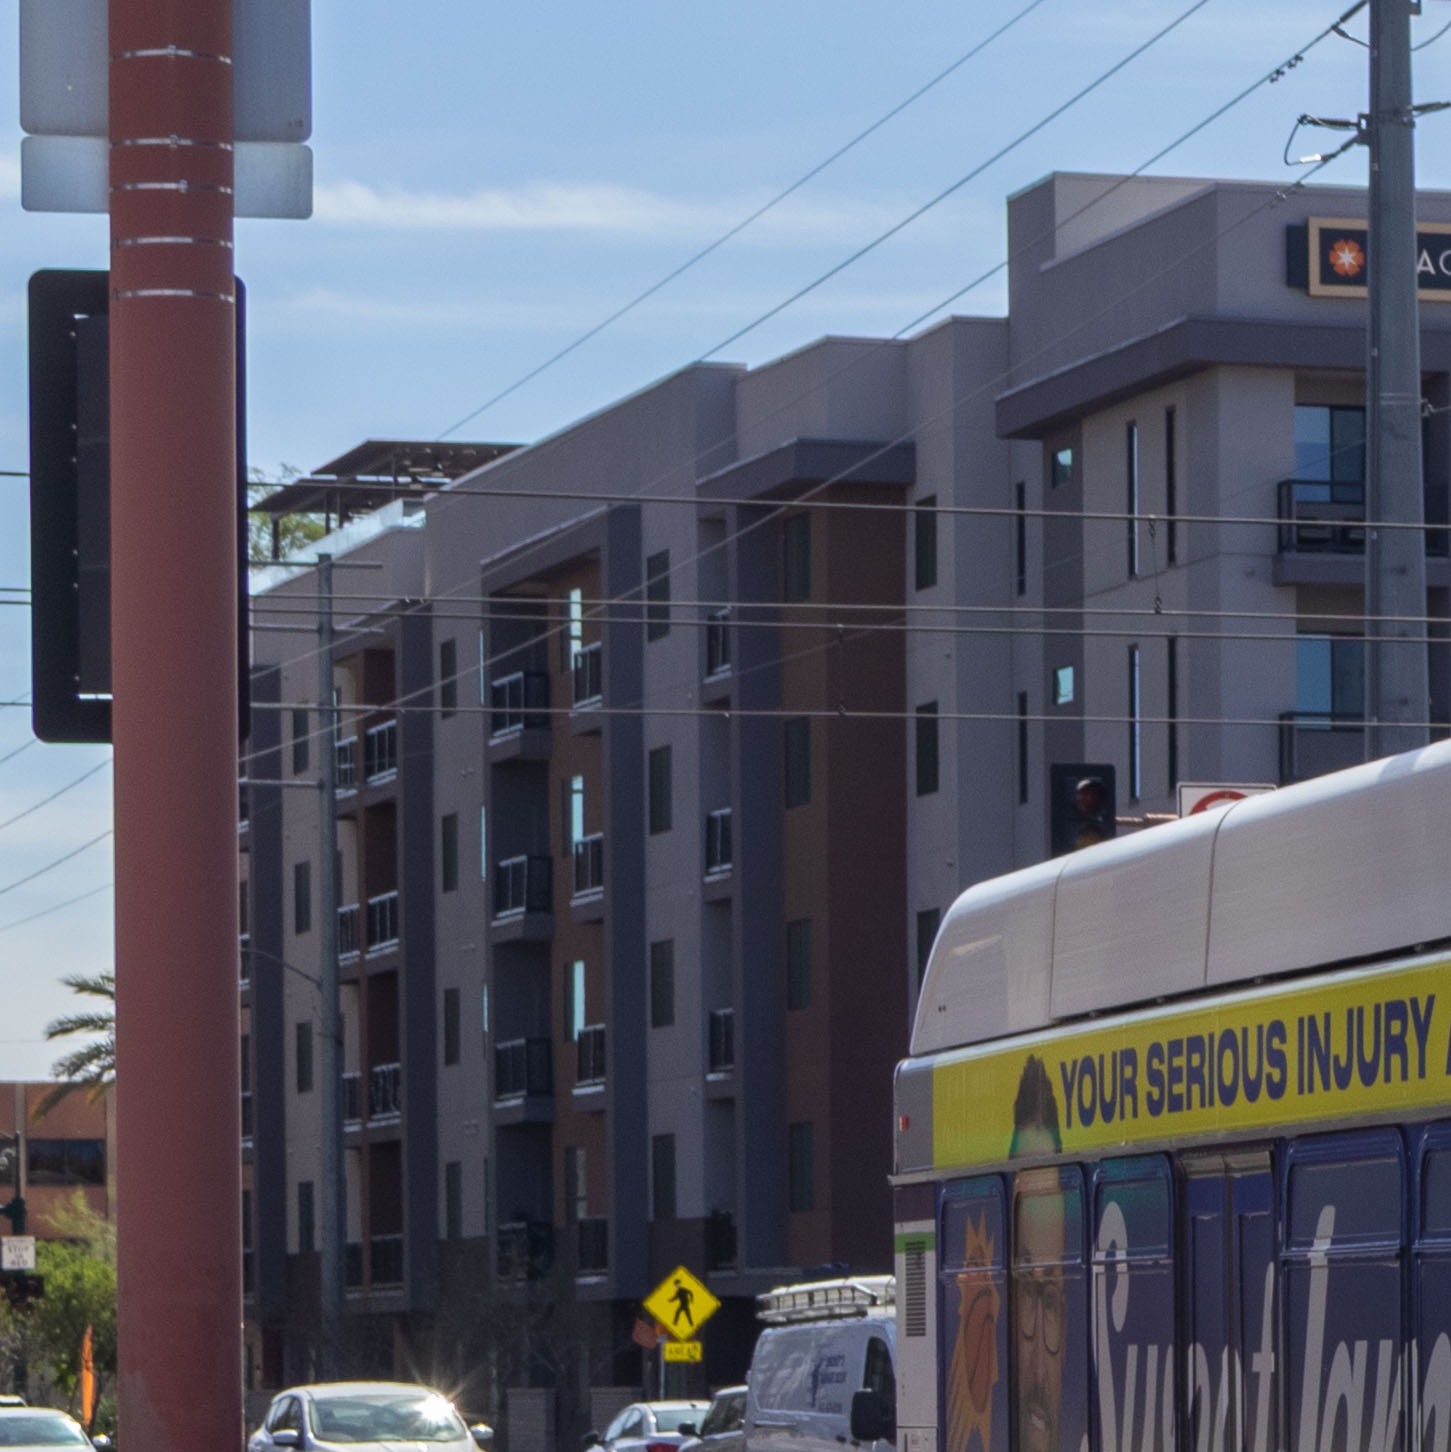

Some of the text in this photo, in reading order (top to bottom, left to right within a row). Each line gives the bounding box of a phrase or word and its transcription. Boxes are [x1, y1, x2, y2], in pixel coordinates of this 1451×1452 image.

[1060, 1048, 1138, 1129] YOUR
[1146, 1020, 1288, 1118] SERIOUS
[1298, 994, 1436, 1095] INJURY
